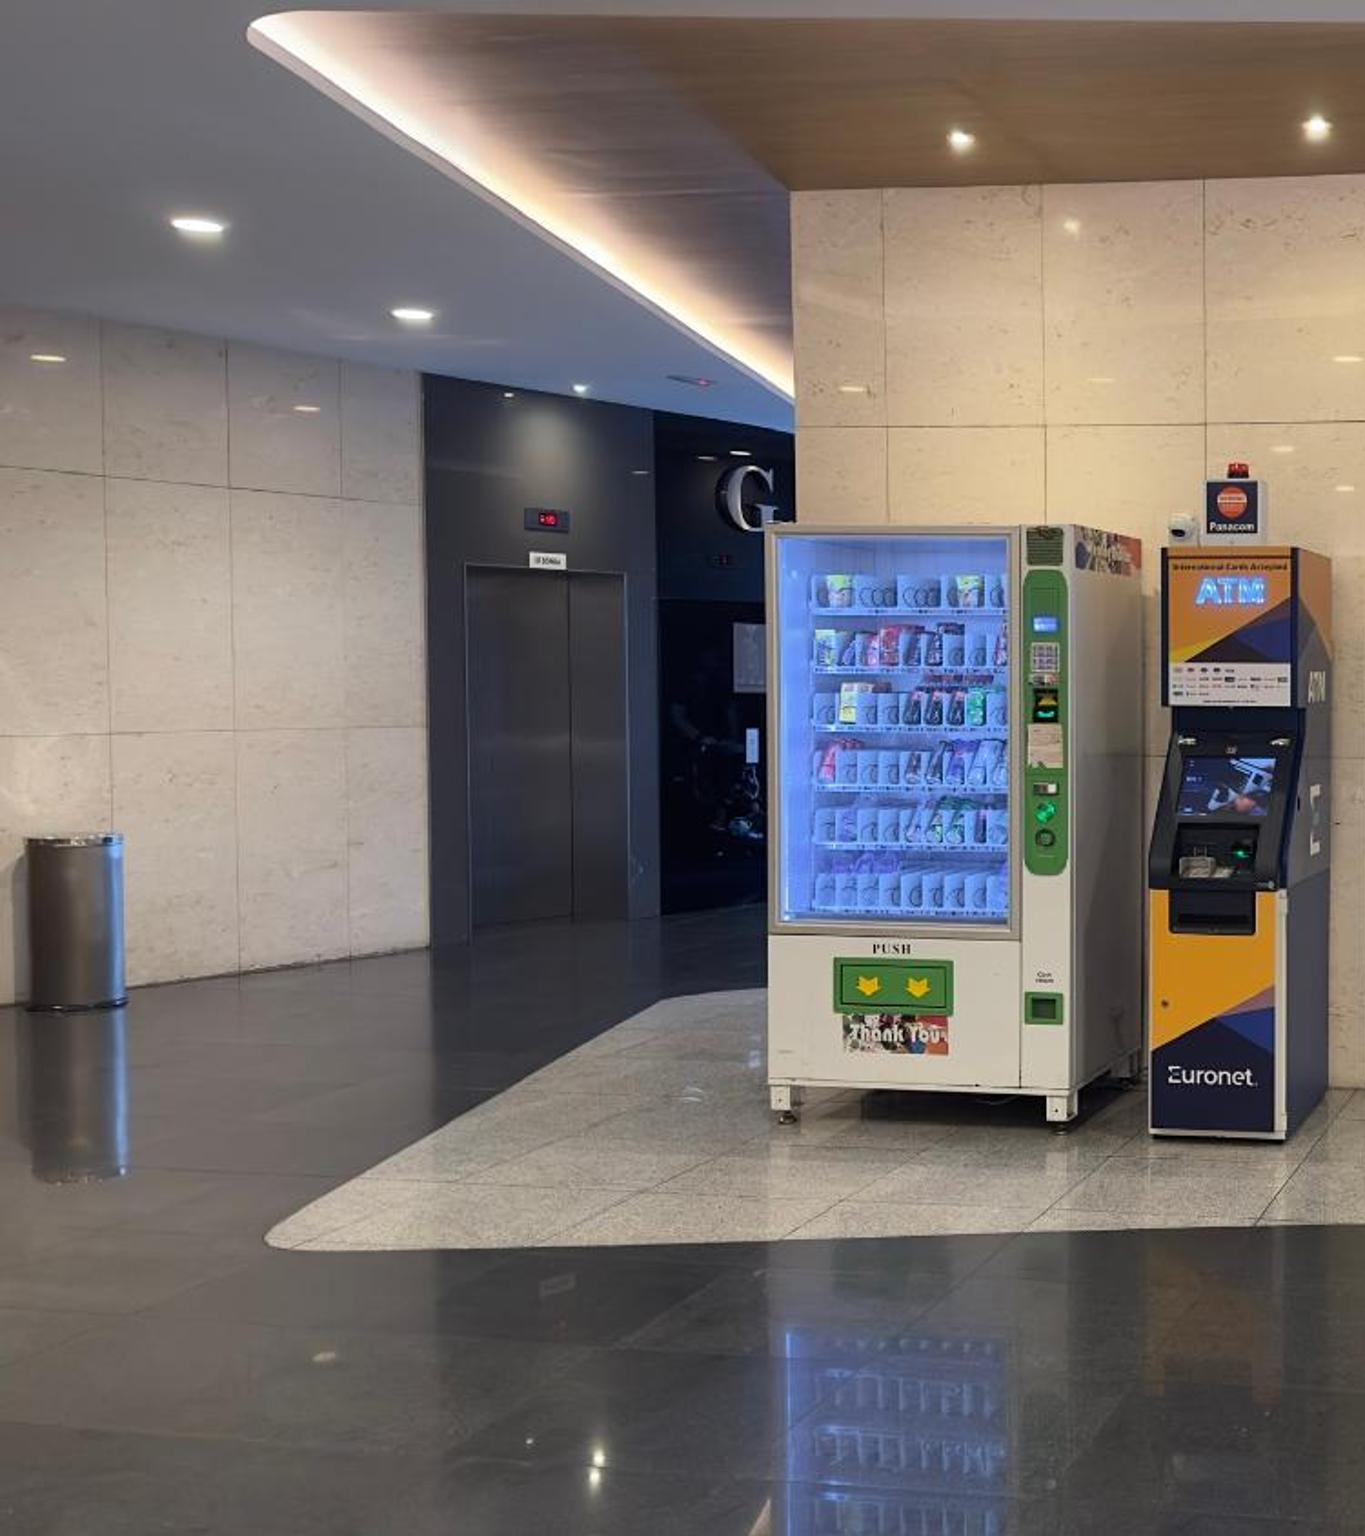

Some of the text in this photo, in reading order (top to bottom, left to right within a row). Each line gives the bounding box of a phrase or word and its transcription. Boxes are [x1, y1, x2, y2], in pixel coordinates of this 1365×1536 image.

[722, 465, 779, 532] G
[1195, 575, 1266, 605] ATM
[872, 943, 912, 955] PUSH
[849, 1022, 905, 1044] Thank
[1167, 1065, 1256, 1087] Euronet
